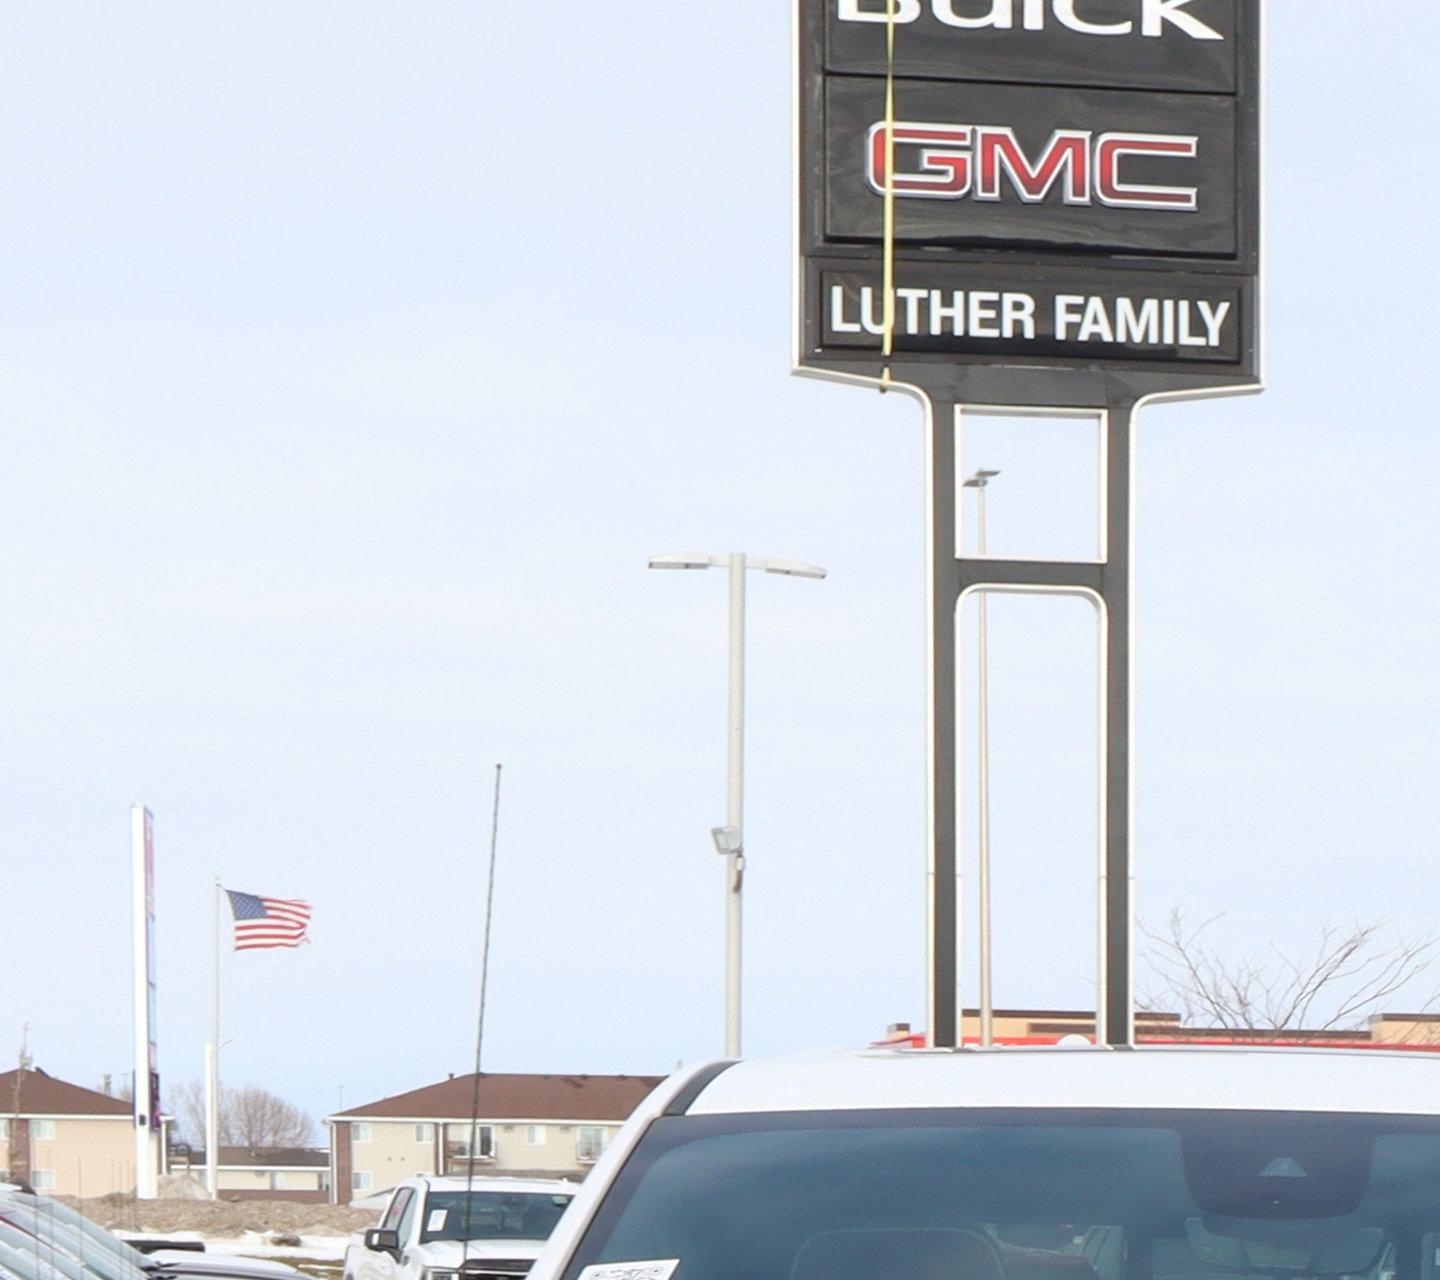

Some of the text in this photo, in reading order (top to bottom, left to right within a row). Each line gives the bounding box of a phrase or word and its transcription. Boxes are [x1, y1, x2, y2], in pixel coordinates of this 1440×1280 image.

[865, 121, 1199, 212] GMC
[830, 284, 1231, 347] LUTHER FAMILY
